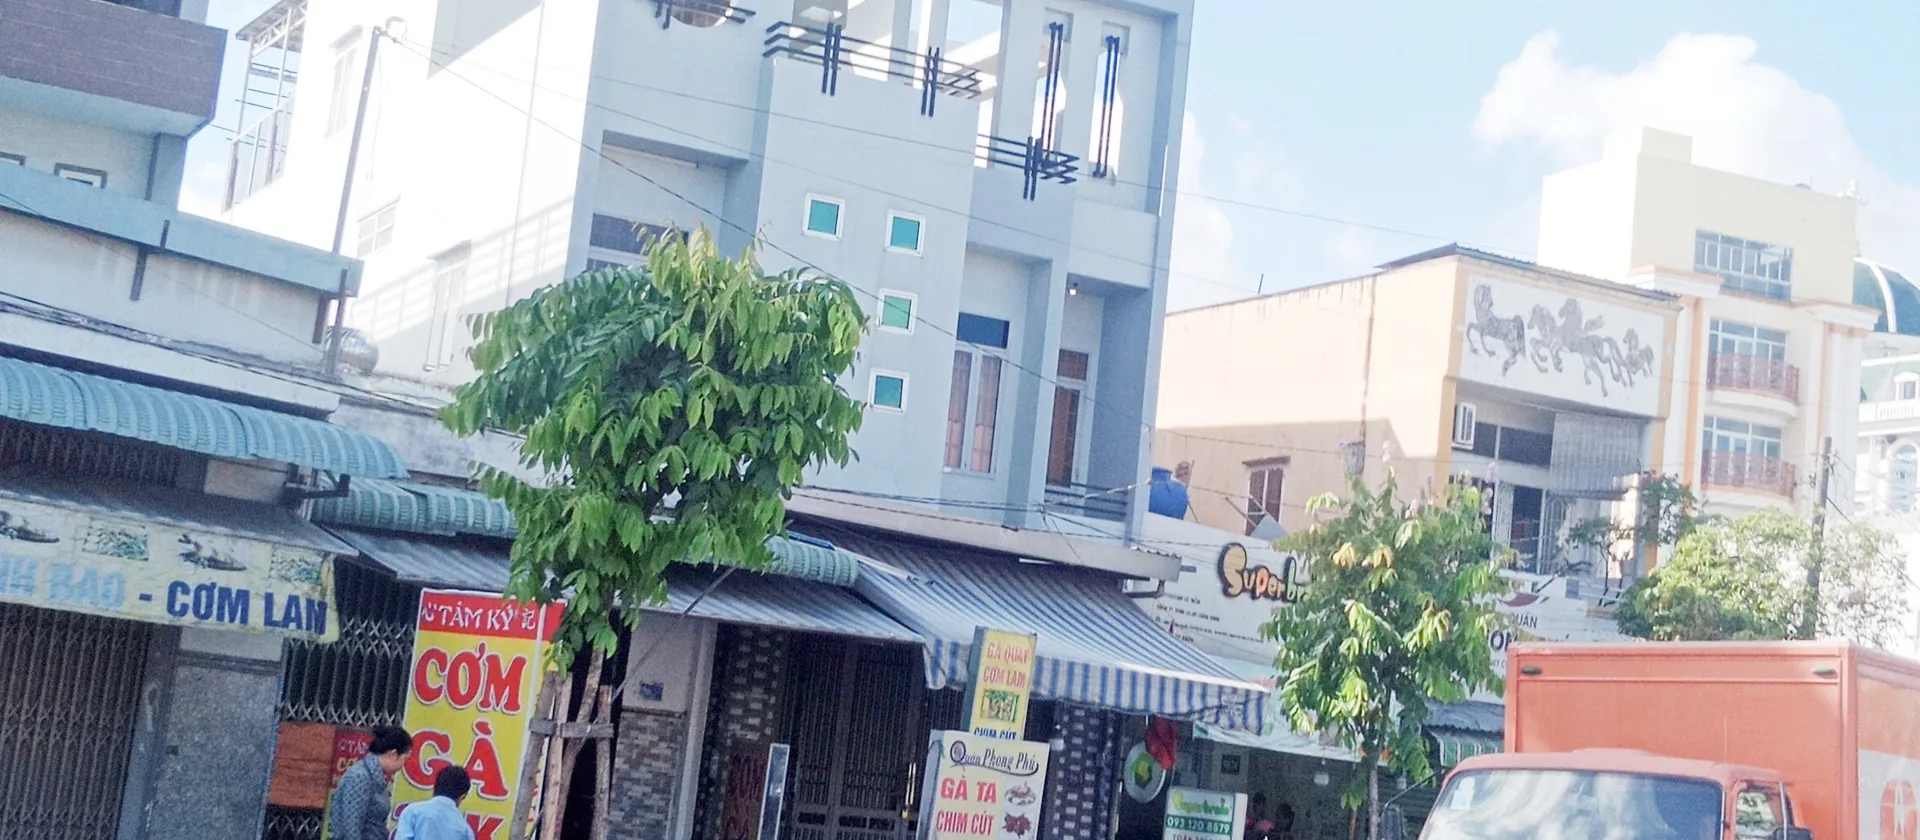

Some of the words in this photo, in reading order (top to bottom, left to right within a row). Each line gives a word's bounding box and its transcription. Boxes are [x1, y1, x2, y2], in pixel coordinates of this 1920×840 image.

[166, 580, 250, 625] CƠM
[413, 641, 528, 715] CƠM
[402, 720, 509, 800] GÀ
[982, 748, 1014, 772] Phong
[941, 775, 968, 801] GÀ
[977, 781, 997, 804] TA
[936, 810, 968, 834] CHIM
[971, 810, 995, 836] CÚT
